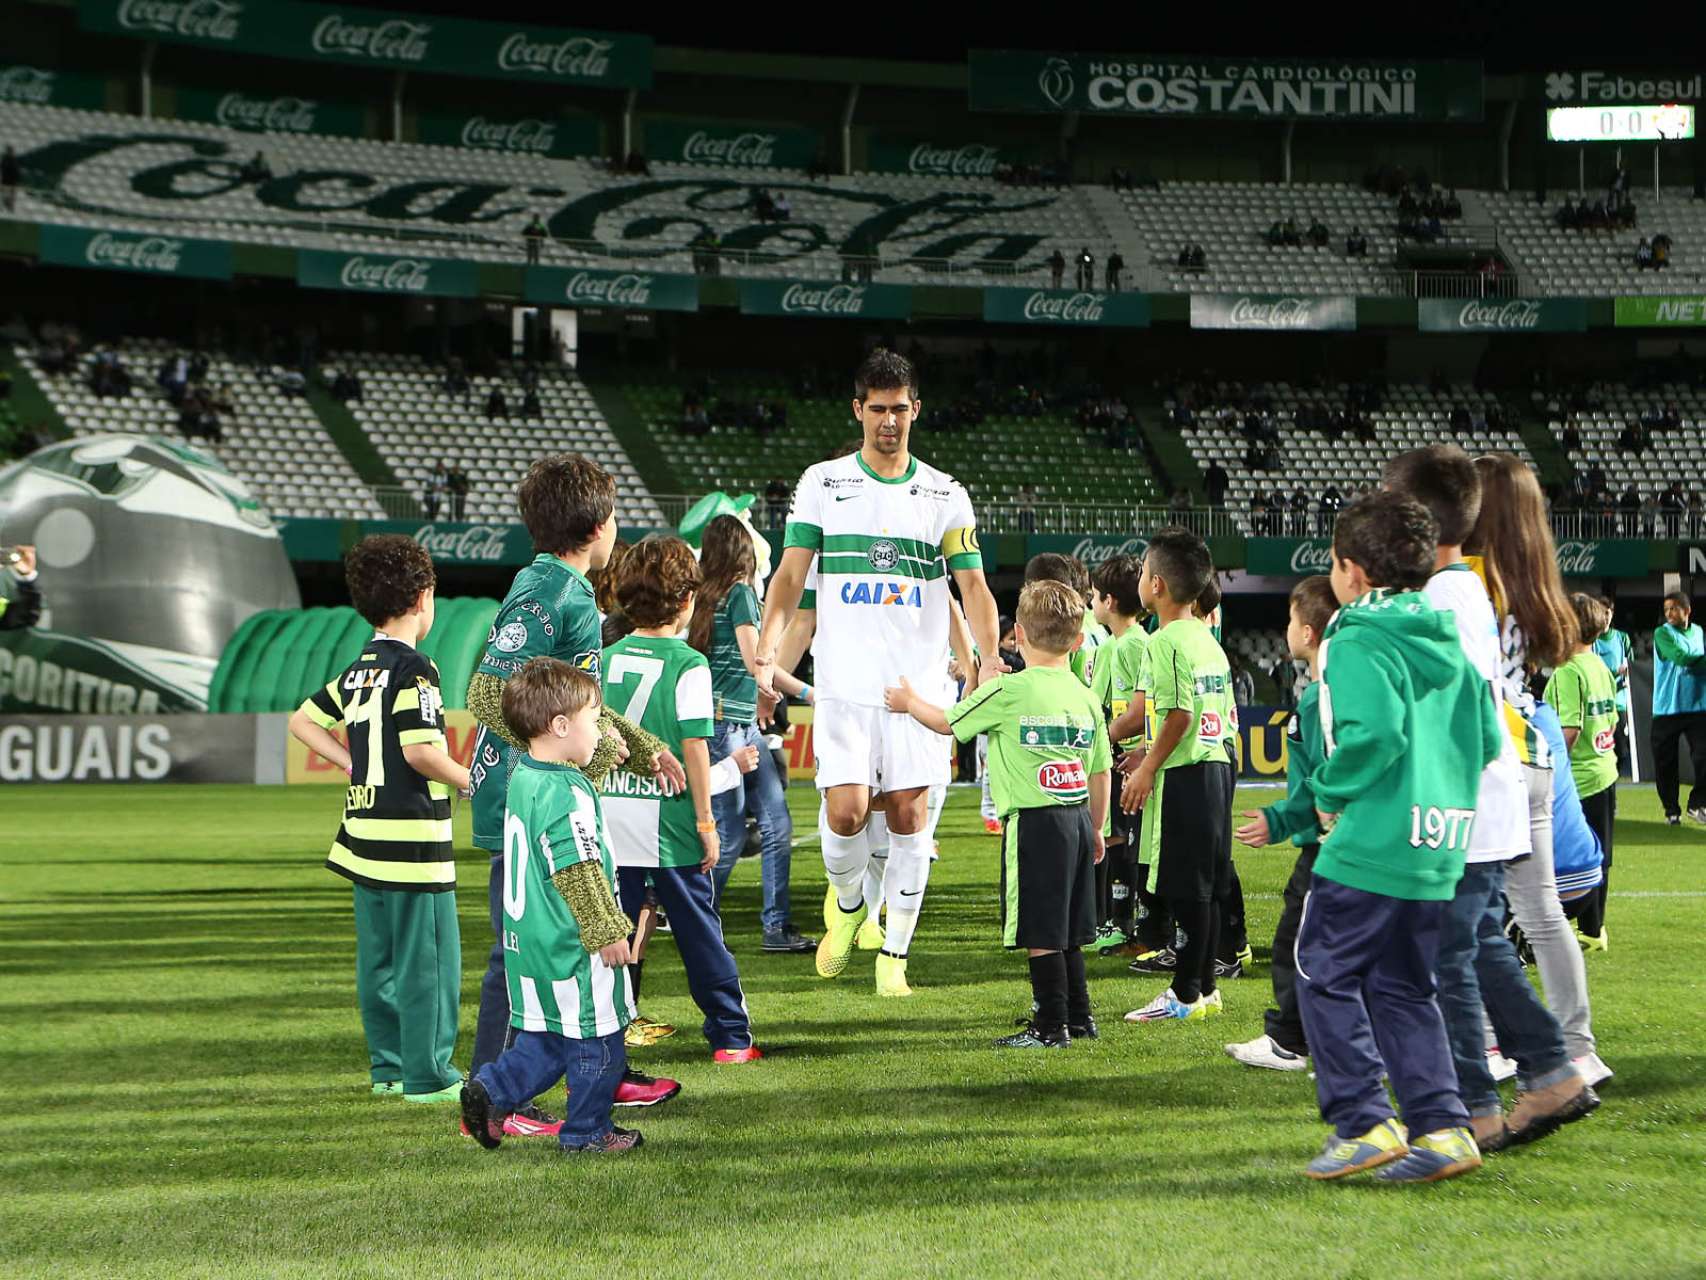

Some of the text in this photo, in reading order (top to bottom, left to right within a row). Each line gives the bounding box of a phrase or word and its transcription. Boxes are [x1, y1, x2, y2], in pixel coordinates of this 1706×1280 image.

[1089, 62, 1417, 81] HOSPITAL CARDIOLÓGICO
[1088, 76, 1416, 114] COSTANTINI
[1581, 72, 1702, 99] Fabesul
[841, 582, 922, 608] CAIXA
[603, 770, 676, 797] ANCISCO
[346, 784, 376, 811] EDRO
[1408, 804, 1476, 851] 1977
